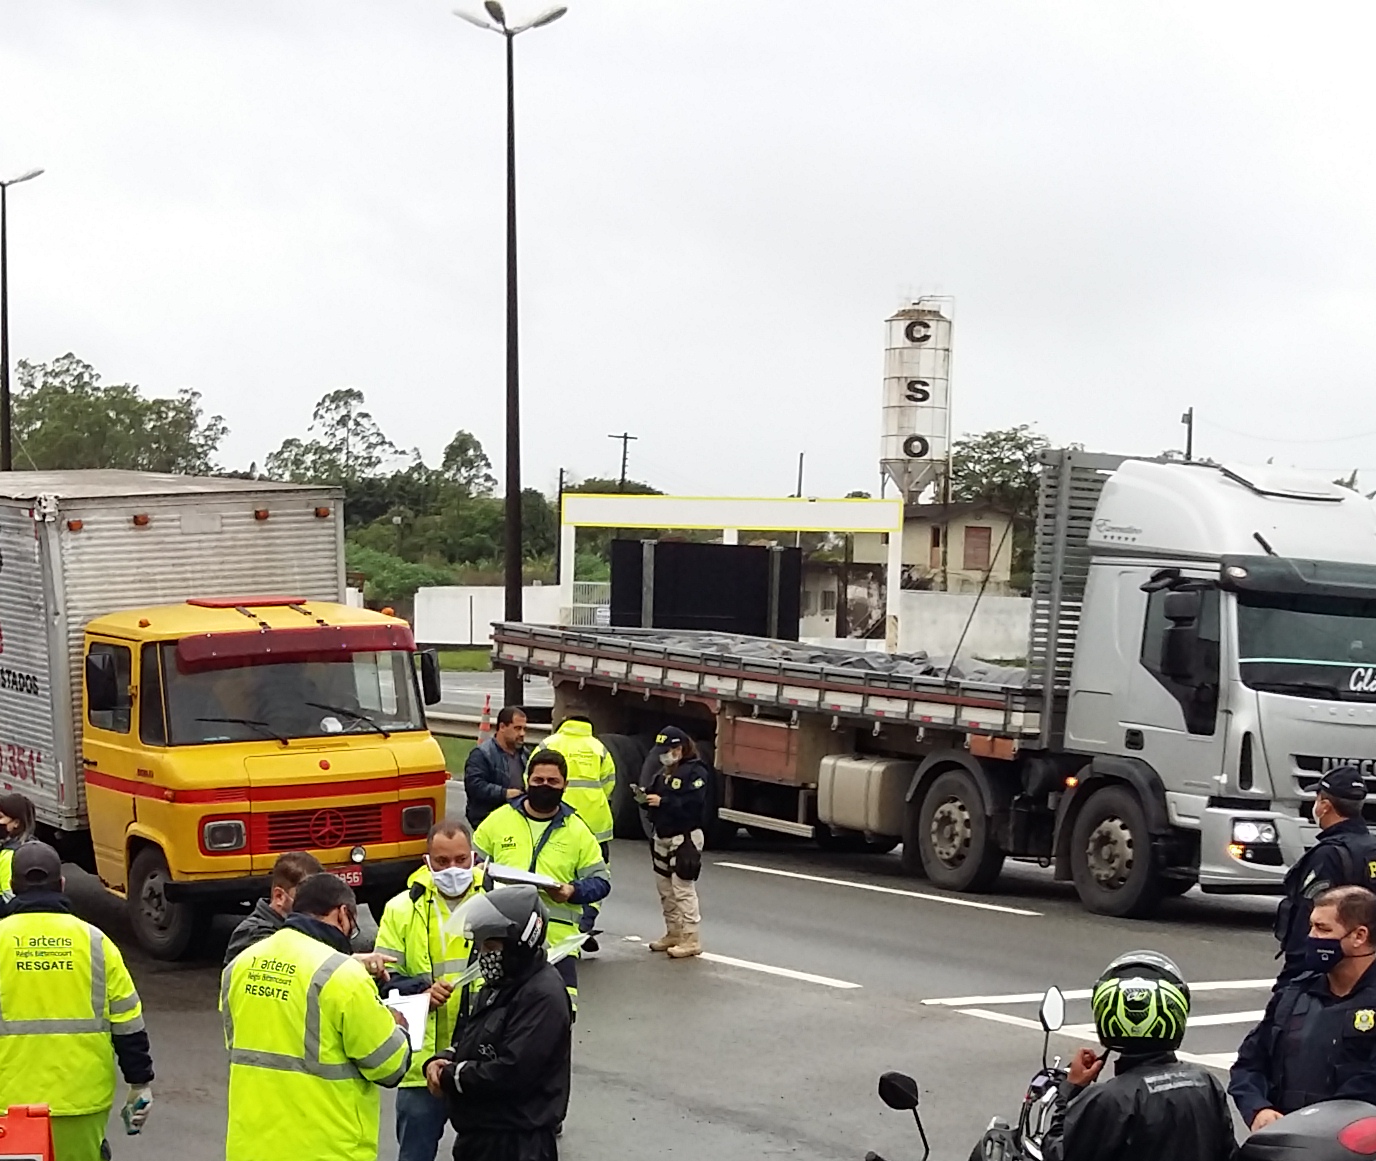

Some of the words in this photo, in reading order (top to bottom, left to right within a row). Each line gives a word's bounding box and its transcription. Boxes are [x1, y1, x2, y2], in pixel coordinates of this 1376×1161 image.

[29, 935, 72, 947] arteris
[16, 961, 74, 971] RESGATE
[260, 958, 297, 974] arteris
[245, 984, 290, 1001] RESGATE
